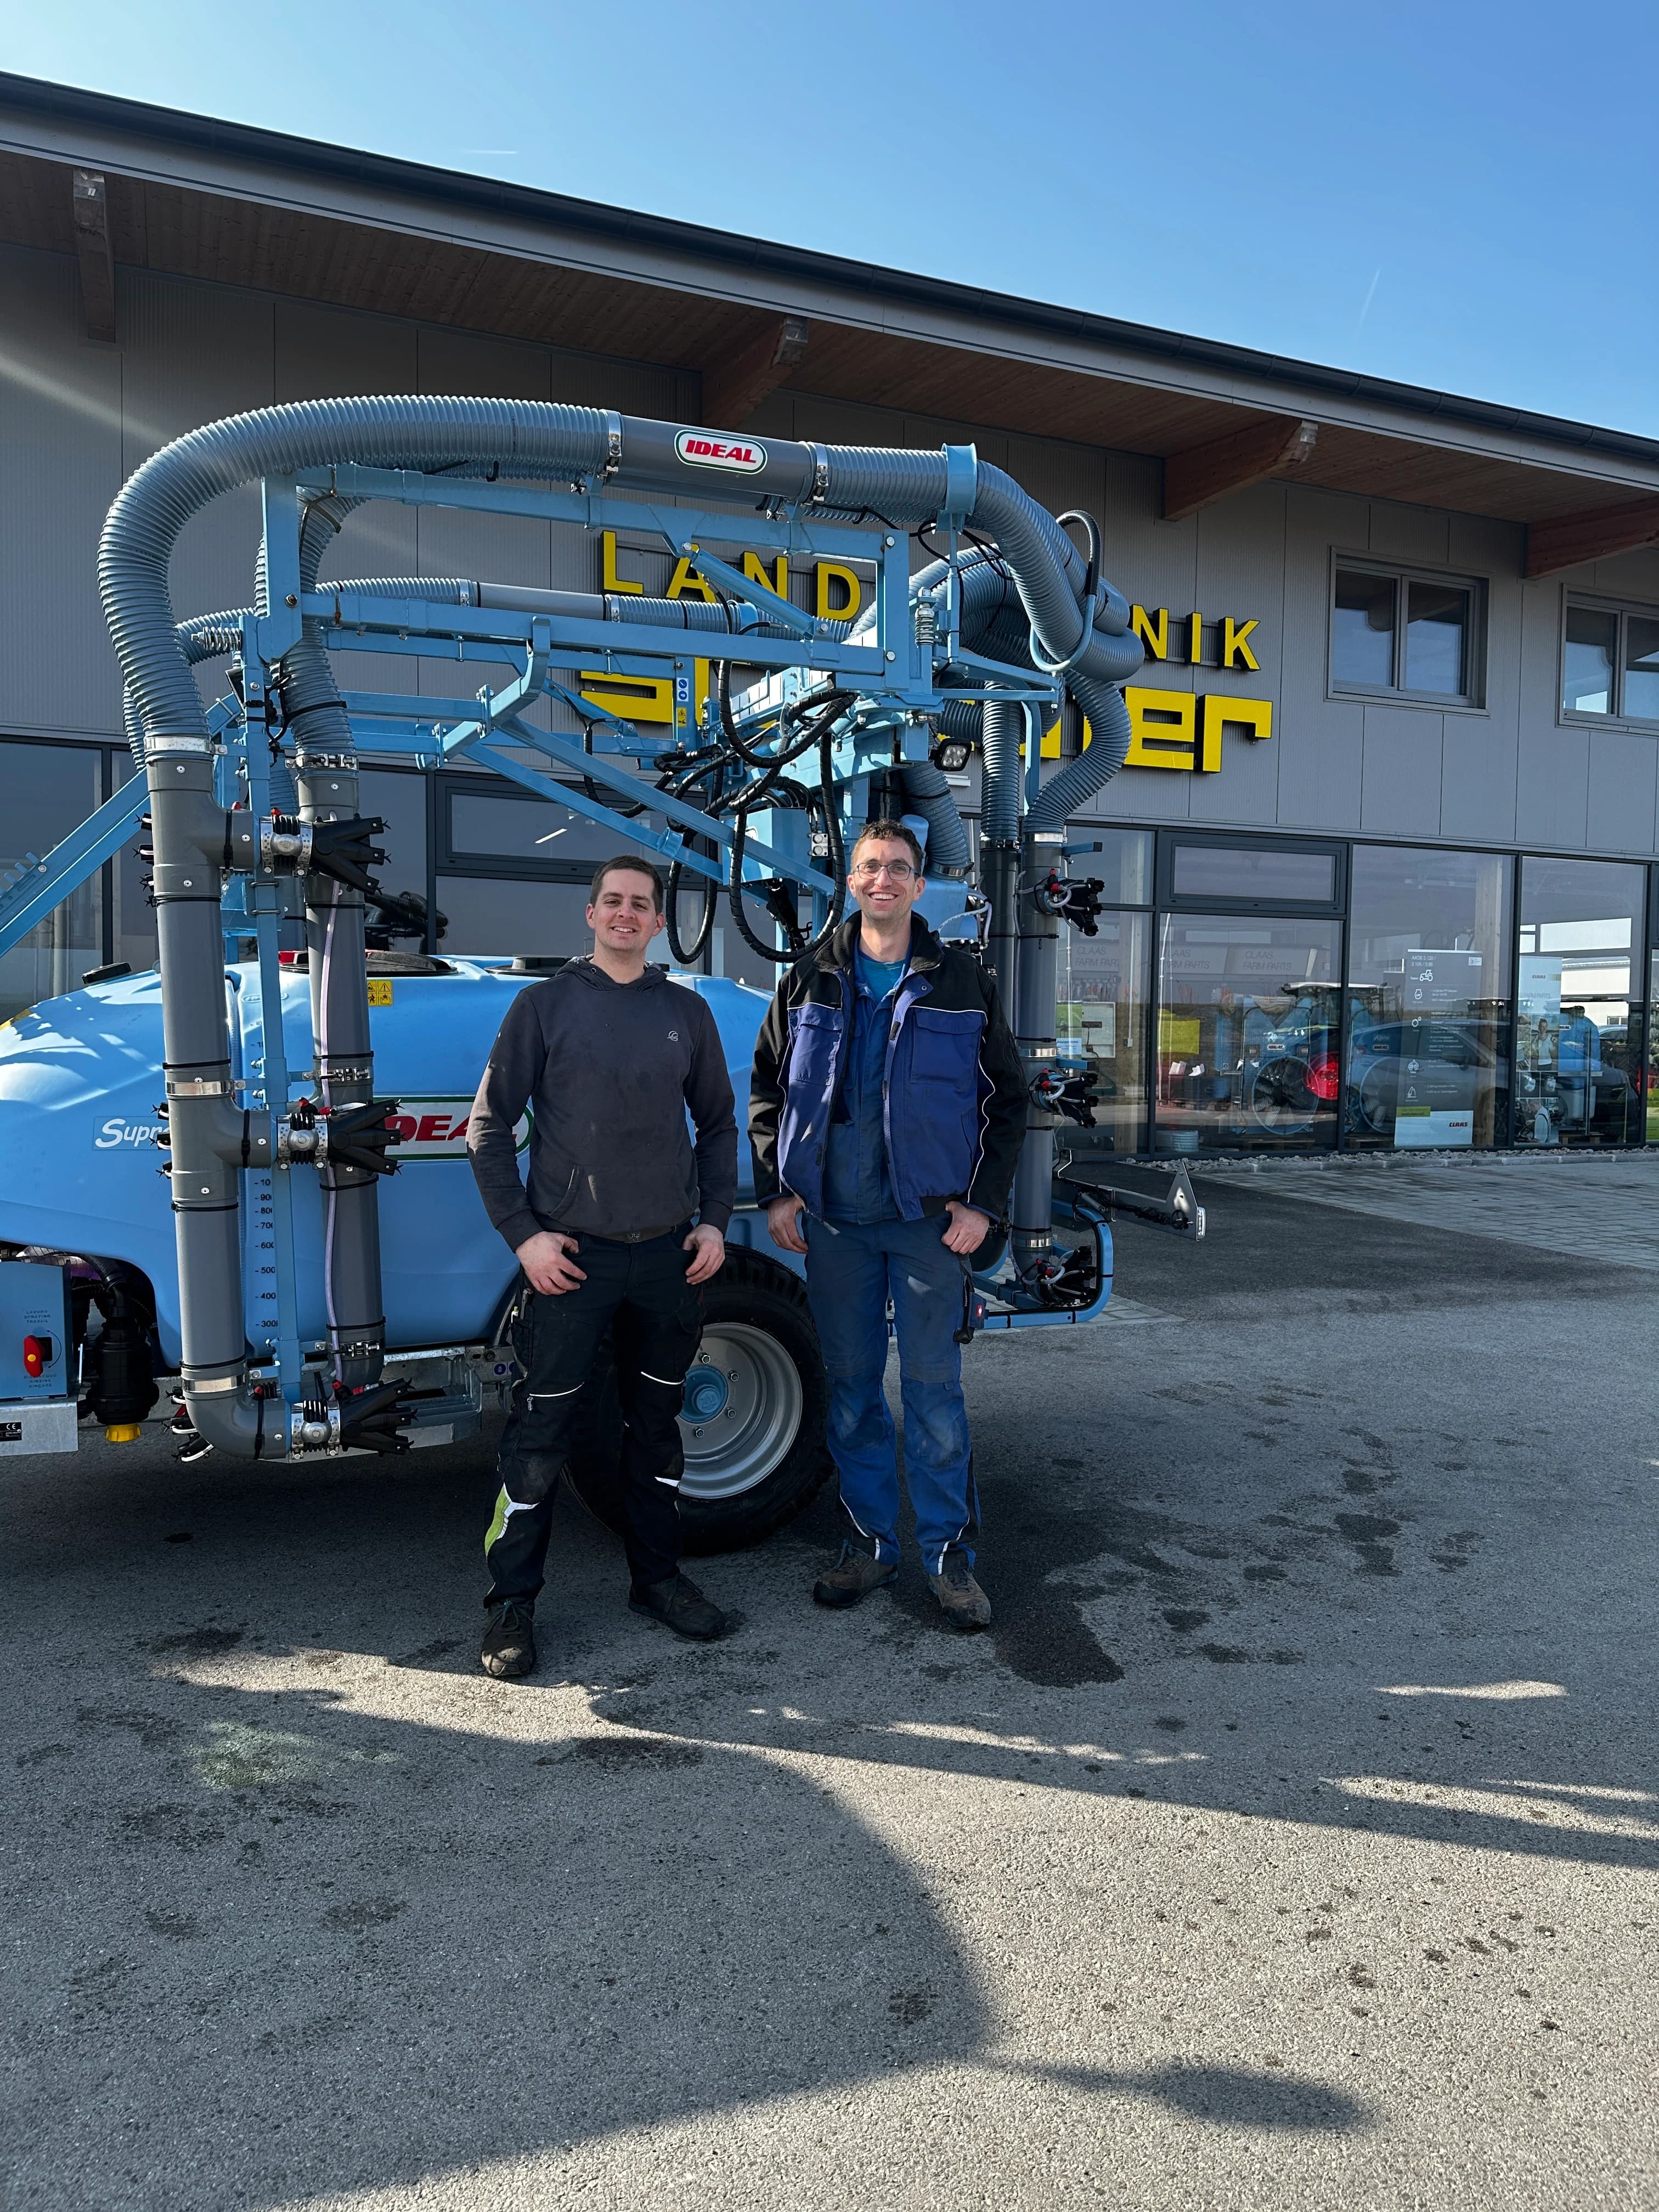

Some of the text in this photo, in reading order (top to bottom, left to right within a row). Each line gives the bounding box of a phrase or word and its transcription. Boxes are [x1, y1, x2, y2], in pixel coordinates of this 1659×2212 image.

[685, 439, 757, 464] IDEAL
[1077, 946, 1107, 955] CLAAS
[1076, 957, 1098, 966] FARM
[95, 1118, 170, 1148] Supr
